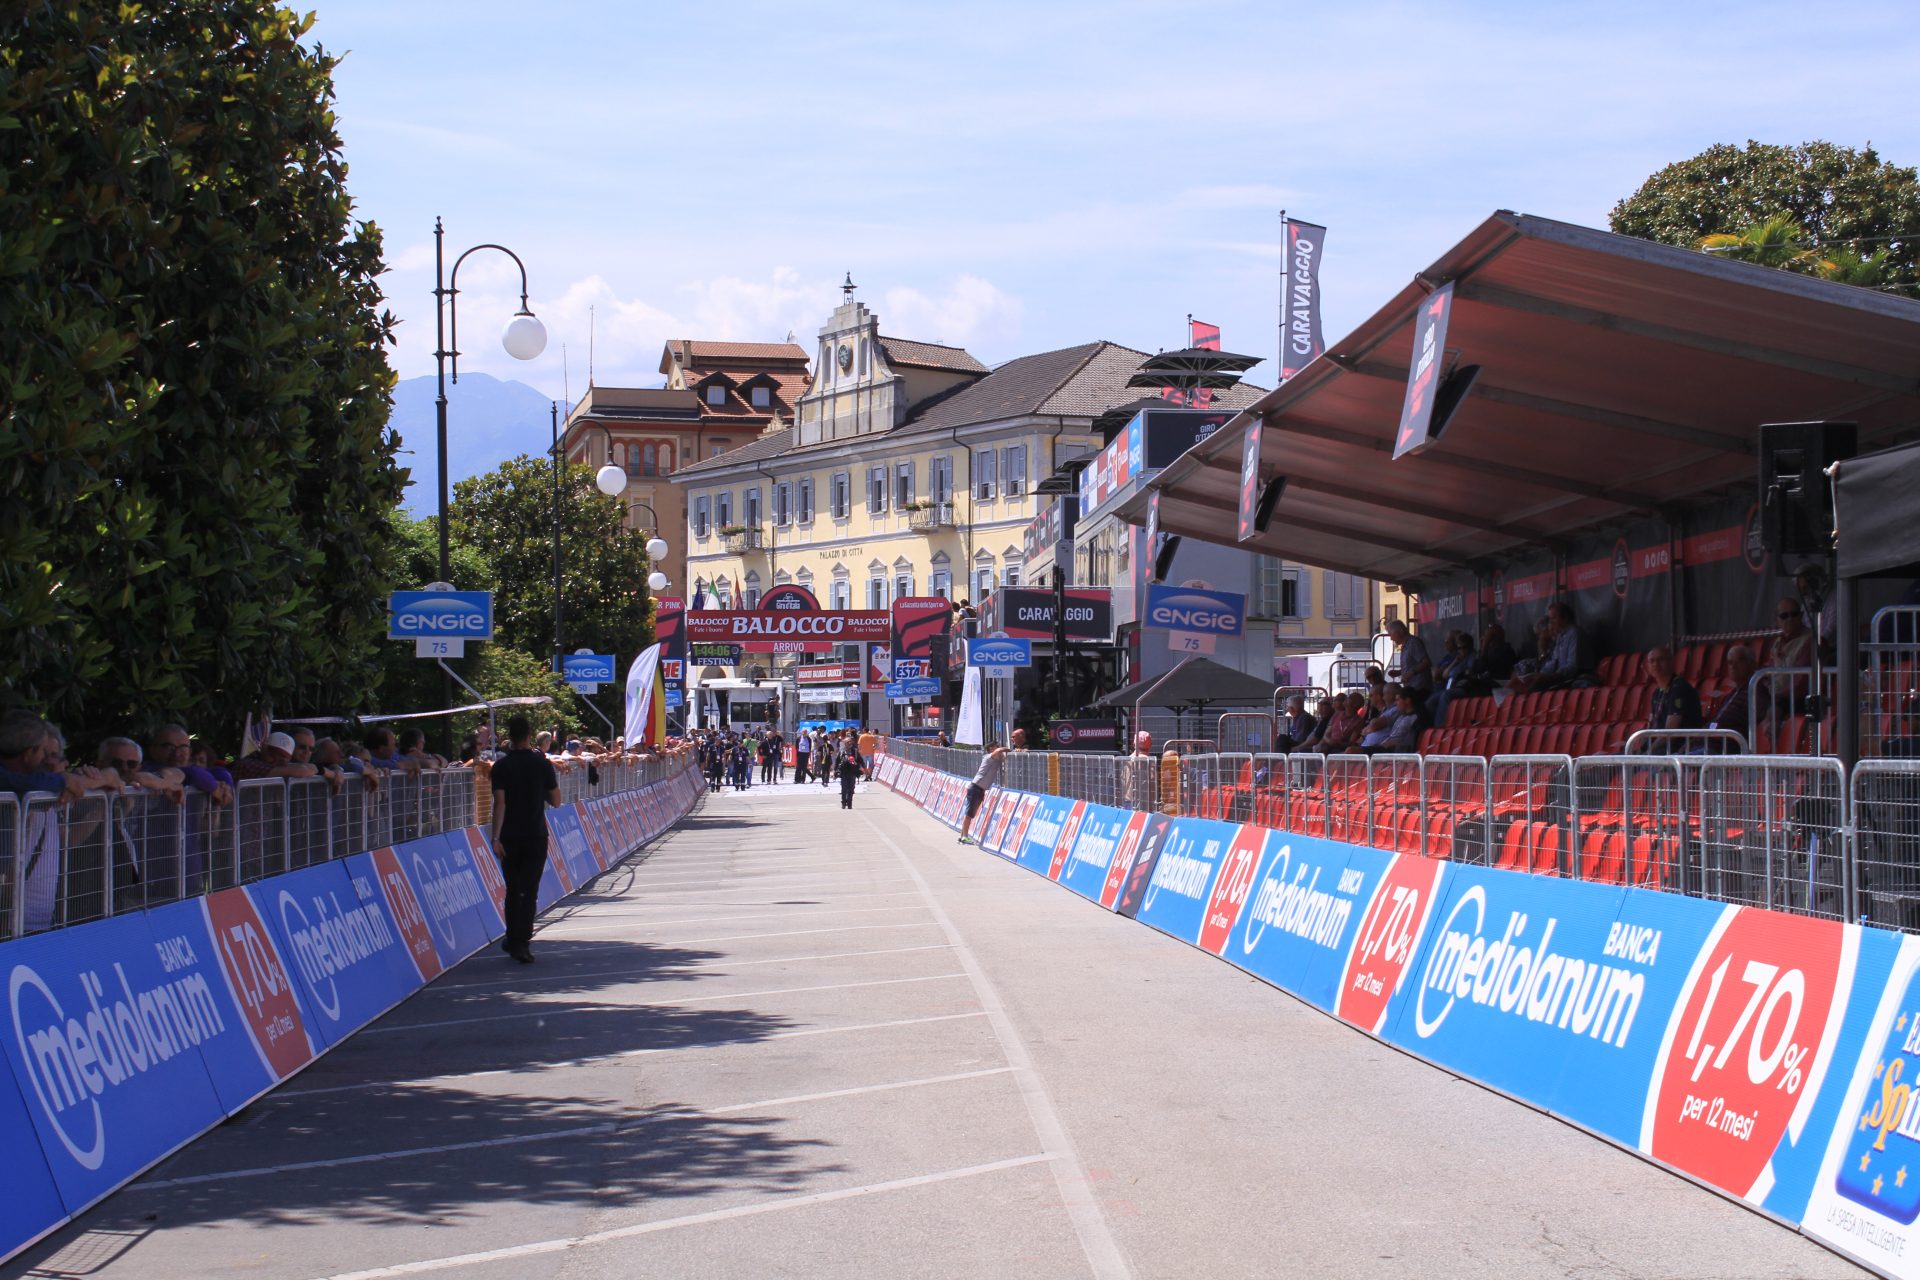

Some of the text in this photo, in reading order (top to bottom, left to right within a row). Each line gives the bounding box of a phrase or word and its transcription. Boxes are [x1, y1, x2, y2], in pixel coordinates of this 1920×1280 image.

[1292, 239, 1314, 355] CARAVAGGIO
[1200, 424, 1216, 432] GIRO
[732, 616, 845, 634] BALOCCO
[1018, 607, 1094, 621] CARAGGIO
[432, 642, 448, 653] 75
[693, 645, 730, 656] 1:44:06
[773, 643, 805, 652] ARRIVO
[1184, 638, 1200, 650] 75
[993, 668, 1003, 676] 50
[1079, 728, 1115, 737] CARAVAGGIO
[1152, 838, 1212, 900] mediolanum
[1337, 868, 1364, 895] BANCA
[1261, 862, 1353, 950] mediolanum
[1361, 882, 1412, 965] 1,70%
[156, 935, 197, 973] BANCA
[293, 883, 394, 984] mediolanum
[1603, 921, 1662, 966] BANCA
[221, 921, 288, 1019] 1,70%
[1429, 911, 1646, 1048] mediolanum
[28, 962, 226, 1113] mediolanum
[1685, 952, 1810, 1095] 1,70%
[1679, 1094, 1759, 1141] per 12 mesi
[1827, 1206, 1907, 1258] LA SPESA INTELLIGENTE
